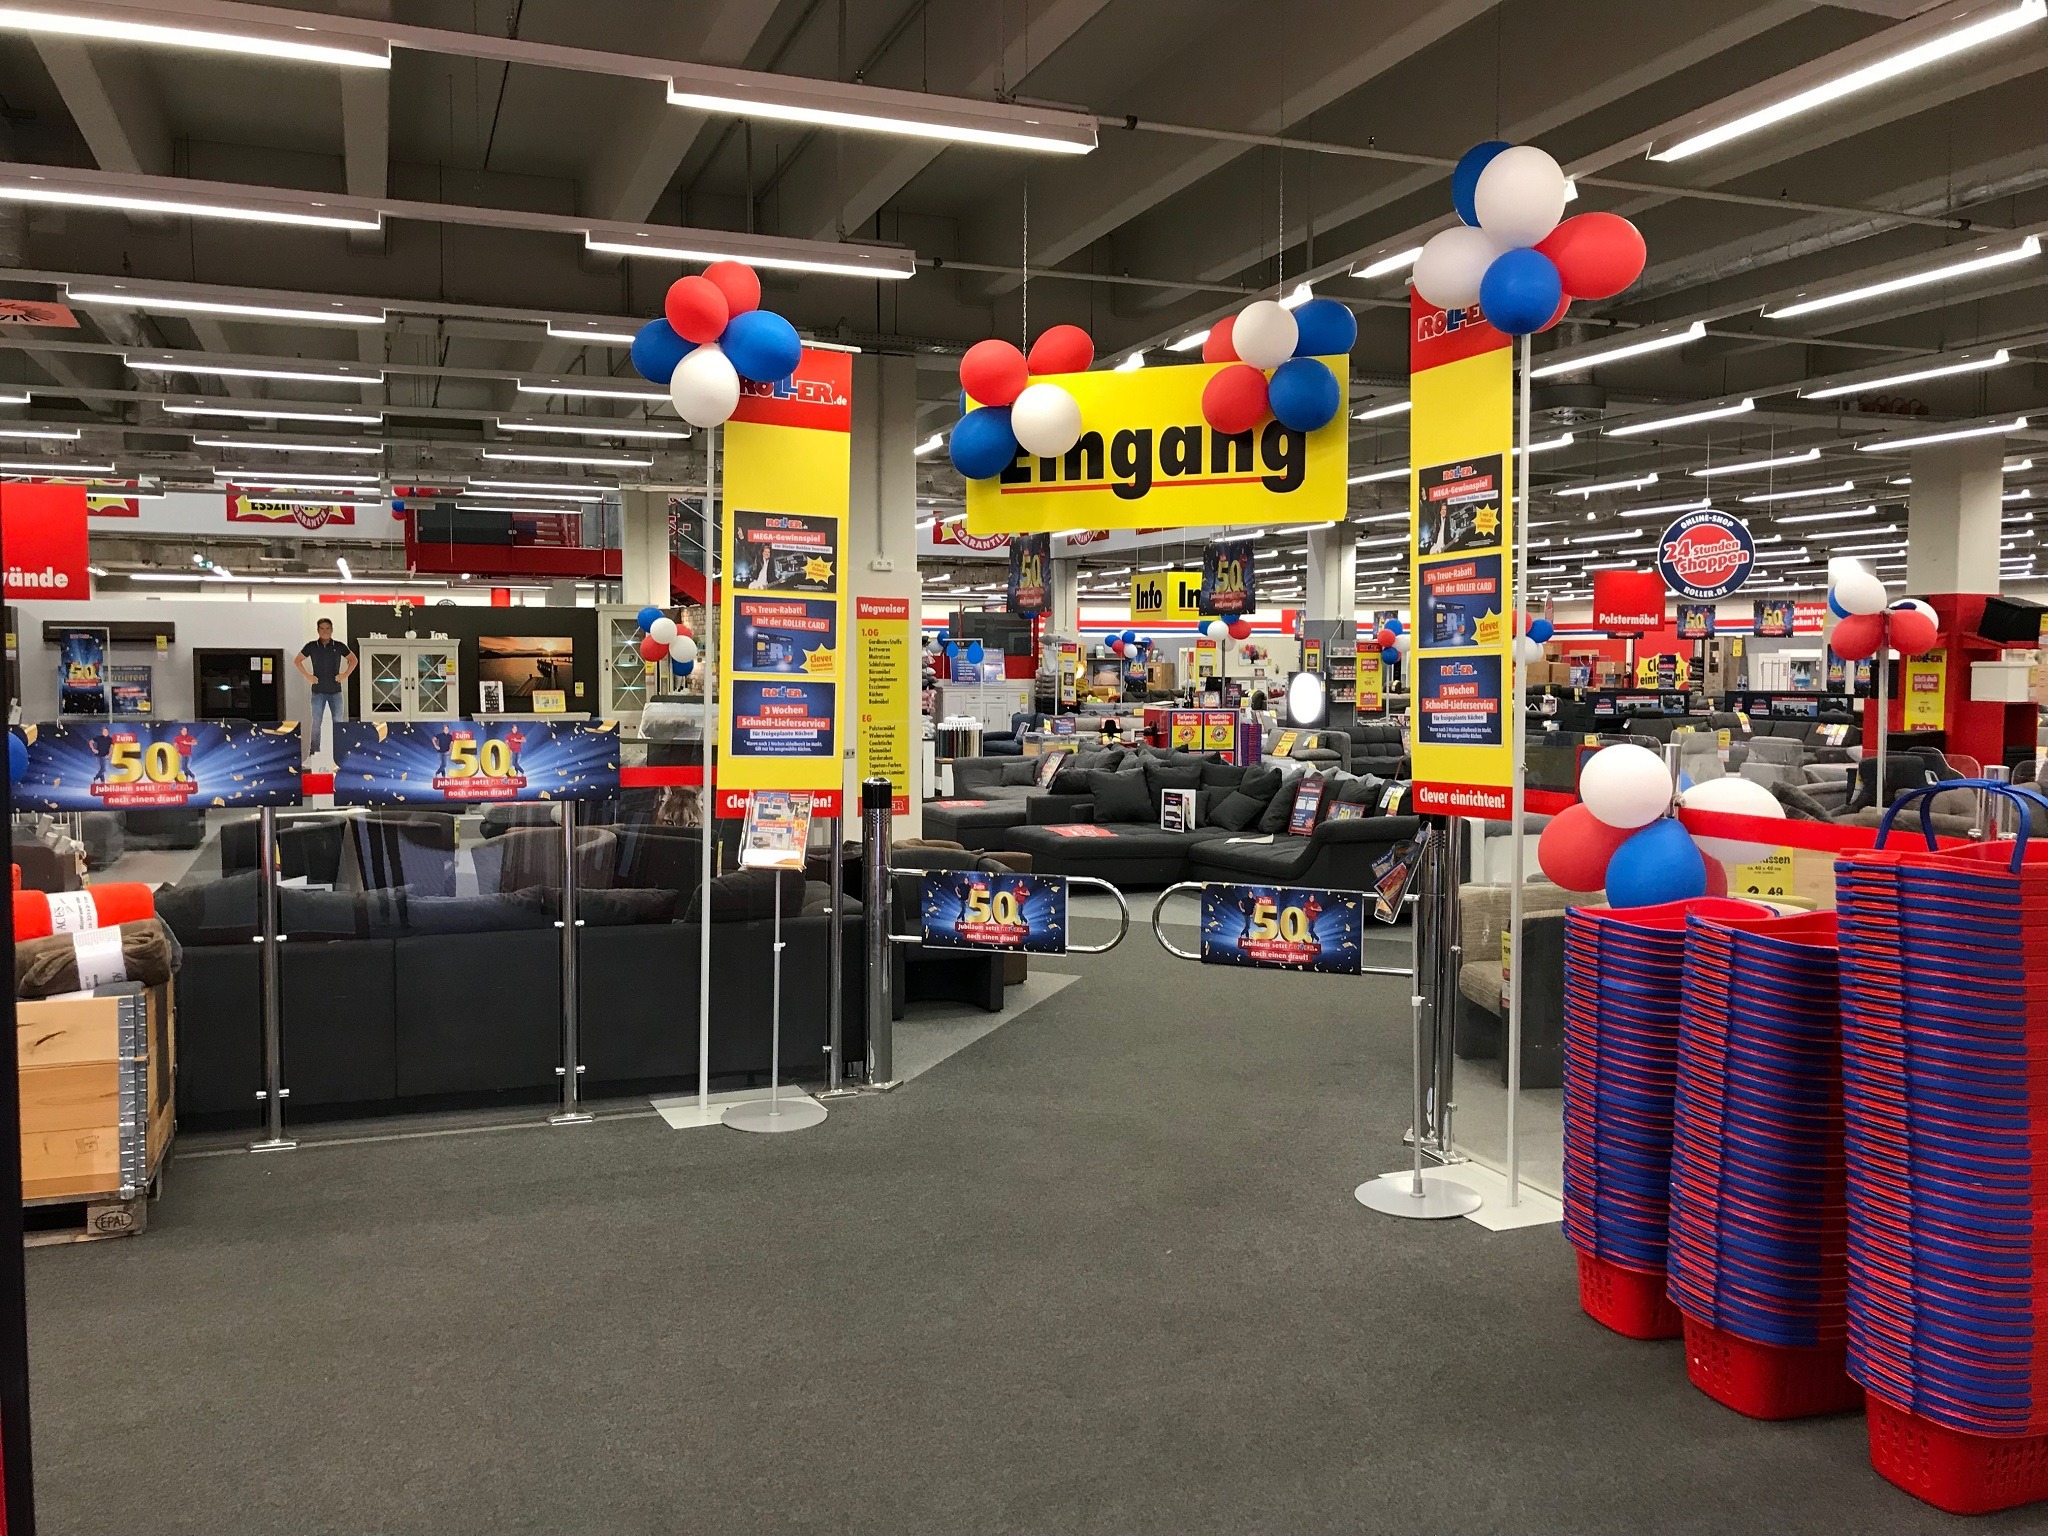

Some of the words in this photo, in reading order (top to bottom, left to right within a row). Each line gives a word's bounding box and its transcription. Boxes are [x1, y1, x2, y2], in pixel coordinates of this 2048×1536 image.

[1418, 305, 1487, 342] ROLLE
[1433, 479, 1488, 497] MEGA-Gewinnspiel
[1680, 515, 1734, 529] ONLINE-SHOP
[753, 533, 820, 543] MEGA-Gewinnspiel
[1663, 539, 1692, 563] 24
[1693, 539, 1740, 555] Stunden
[1679, 550, 1749, 574] shoppen
[1437, 567, 1472, 580] Treue-Rabatt
[1446, 583, 1455, 592] der
[1456, 583, 1476, 592] ROLLER
[1477, 582, 1492, 590] CARD
[1683, 586, 1728, 597] ROLLER.DE
[1136, 580, 1162, 610] Info
[1179, 581, 1201, 608] In
[758, 605, 802, 614] Treue-Rabatt
[860, 603, 905, 615] Wegweiser
[756, 617, 768, 625] mit
[770, 618, 781, 626] der
[782, 619, 806, 628] ROLLER
[807, 621, 826, 630] CARD
[1599, 613, 1659, 626] Polstermöbel
[861, 628, 879, 636] 1.OG
[810, 653, 832, 663] Clever
[1647, 659, 1679, 673] Clr
[1640, 669, 1684, 685] einrn!
[1442, 687, 1448, 695] 3
[1448, 685, 1475, 695] Wochen
[764, 706, 770, 714] 3
[771, 705, 804, 714] Wochen
[1425, 699, 1494, 710] Schnell-Lieferservice
[742, 718, 826, 728] Schnell-Lieferservice
[862, 714, 872, 722] EG
[107, 742, 187, 783] 50.
[447, 739, 517, 778] 50.
[437, 779, 469, 787] Jubiläum
[95, 785, 133, 793] Jubiläum
[448, 788, 466, 797] noch
[490, 788, 513, 796] drauf!
[108, 794, 129, 803] noch
[157, 794, 183, 802] drauf!
[727, 794, 751, 808] Clev
[1419, 787, 1449, 803] Clever
[1450, 789, 1506, 808] einrichten!
[1760, 856, 1790, 864] ssen
[966, 889, 1021, 926] 50.
[957, 923, 984, 931] Jubiläum
[1251, 904, 1312, 944] 50.
[1000, 934, 1018, 942] drauf!
[1241, 940, 1270, 948] Jubiläum
[1272, 941, 1287, 949] setzt
[1288, 952, 1309, 961] drauf!
[101, 1215, 129, 1228] EPAL
